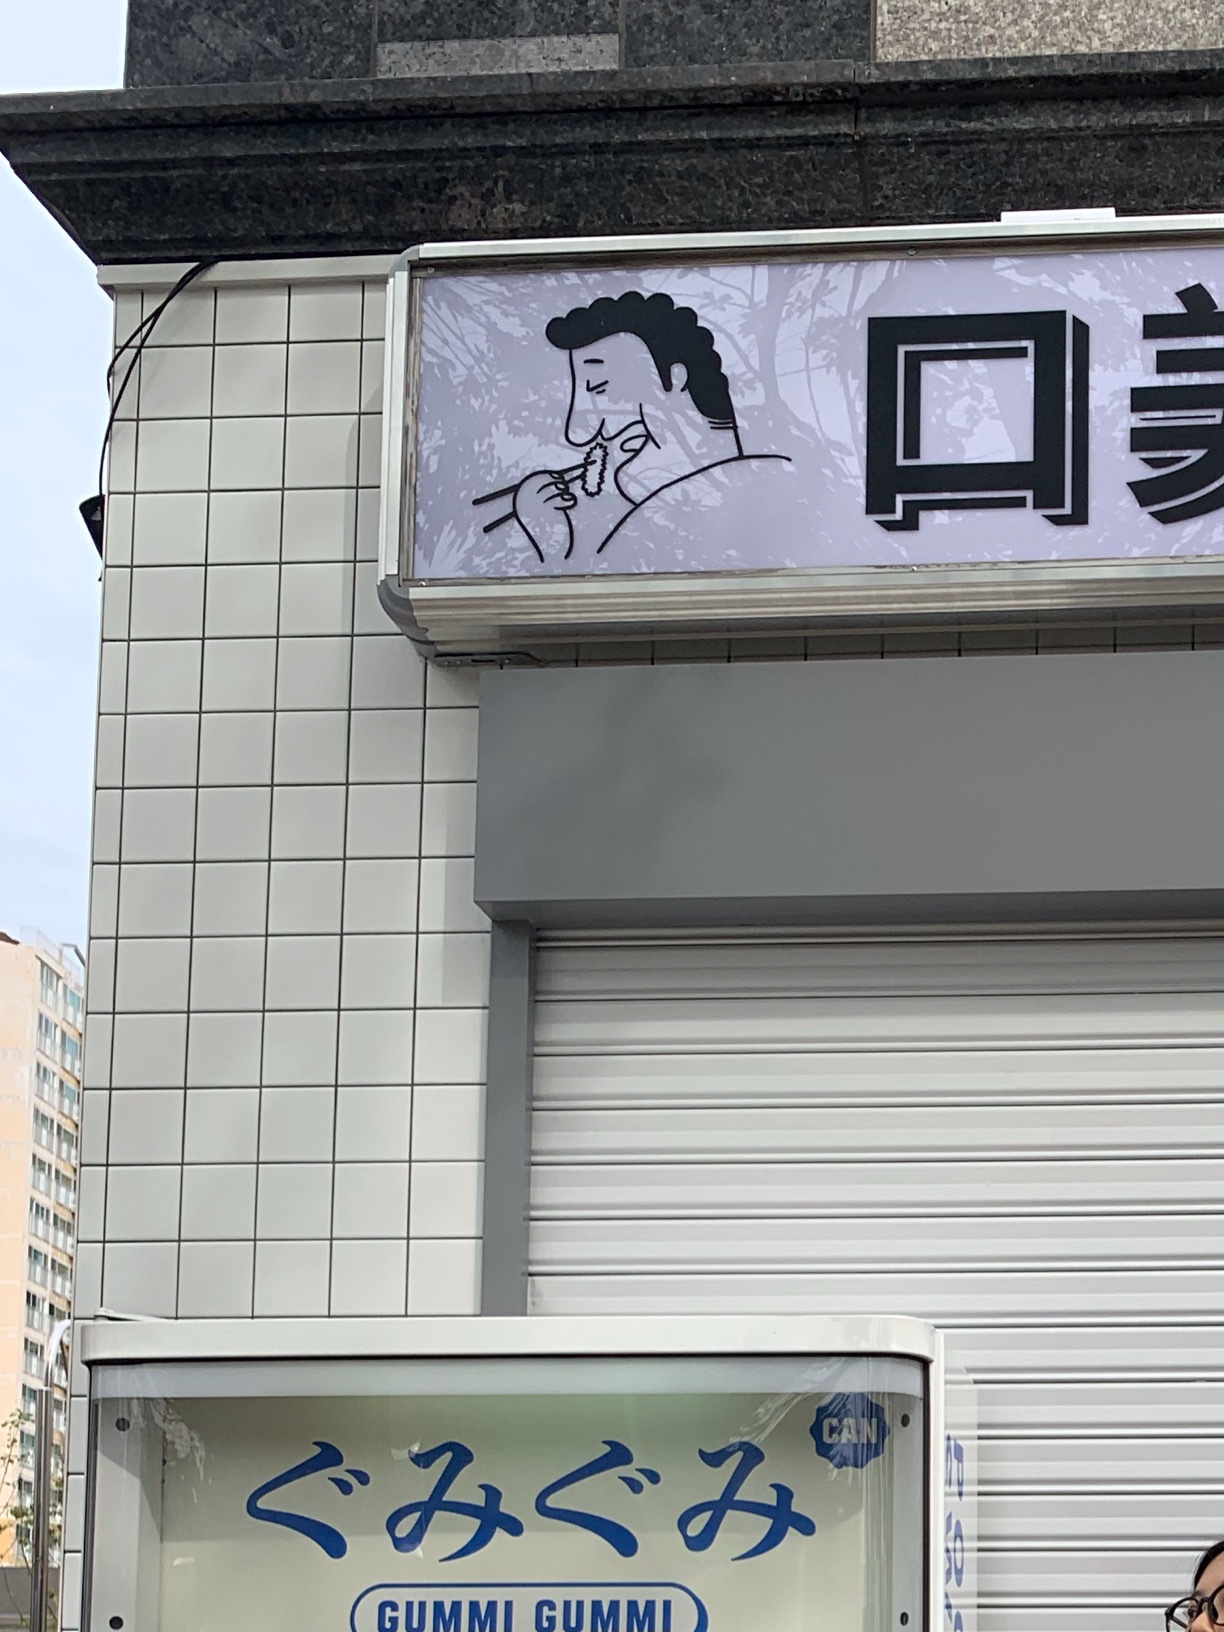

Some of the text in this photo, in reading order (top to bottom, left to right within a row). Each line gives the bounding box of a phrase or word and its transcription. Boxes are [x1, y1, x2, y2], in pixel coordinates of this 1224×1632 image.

[822, 1417, 877, 1444] CAN
[246, 1440, 816, 1562] ぐみぐみ
